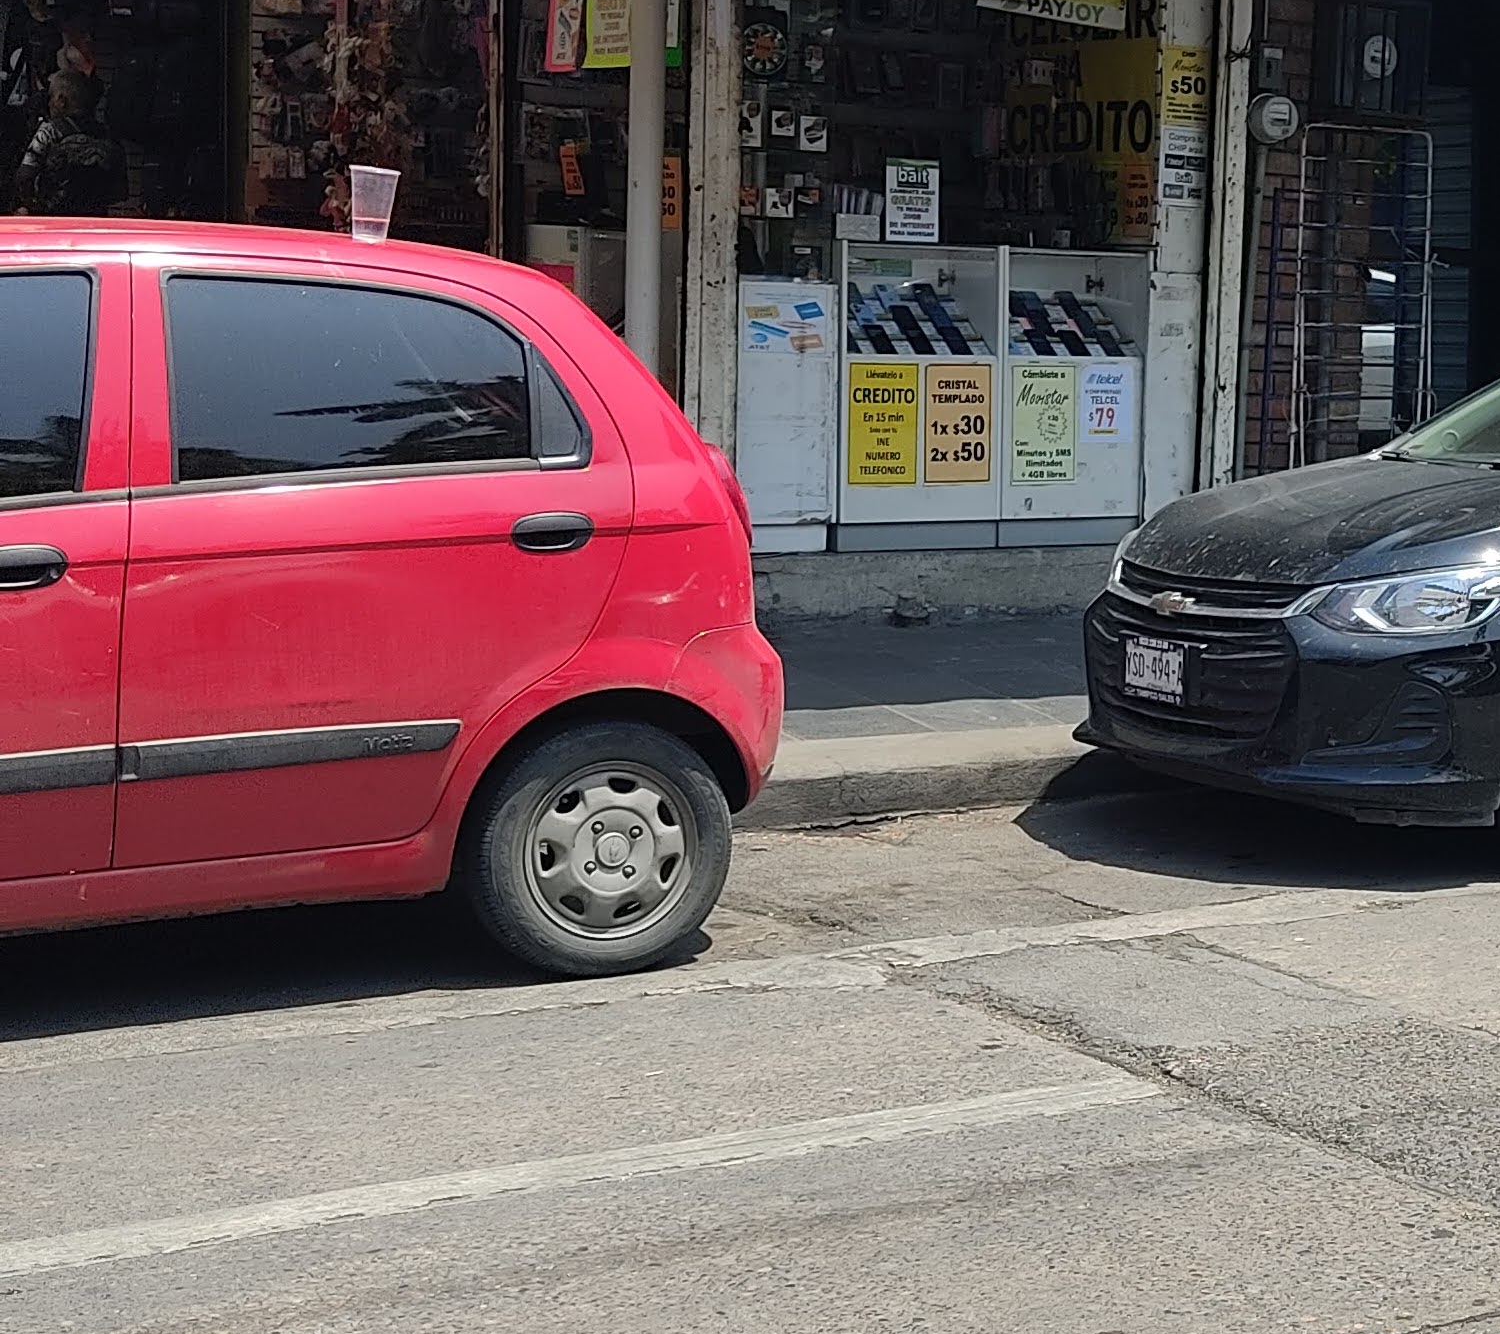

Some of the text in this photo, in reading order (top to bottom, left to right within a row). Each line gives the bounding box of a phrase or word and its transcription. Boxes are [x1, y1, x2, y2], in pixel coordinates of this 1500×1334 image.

[1170, 75, 1206, 95] $50
[898, 165, 929, 184] bait
[890, 195, 933, 207] GRATIS
[865, 369, 898, 380] Llévatelo
[1095, 373, 1123, 385] telcel
[937, 379, 979, 390] CRISTAL
[852, 387, 915, 404] CREDITO
[931, 393, 985, 404] TEMPLADO
[1015, 382, 1070, 407] Movistar
[1090, 395, 1120, 405] TELCEL
[863, 412, 905, 423] En 15 min
[931, 414, 986, 436] 1x $30
[876, 438, 890, 447] INE
[865, 451, 901, 461] NUMERO
[930, 441, 986, 462] 2x $50
[1016, 449, 1048, 458] Minutos
[1055, 448, 1072, 457] SMS
[1025, 459, 1063, 467] Ilimitados
[859, 465, 906, 475] TELEFONICO
[1046, 470, 1067, 478] libres
[1126, 650, 1183, 686] YSD-494-A
[362, 733, 414, 751] Matiz
